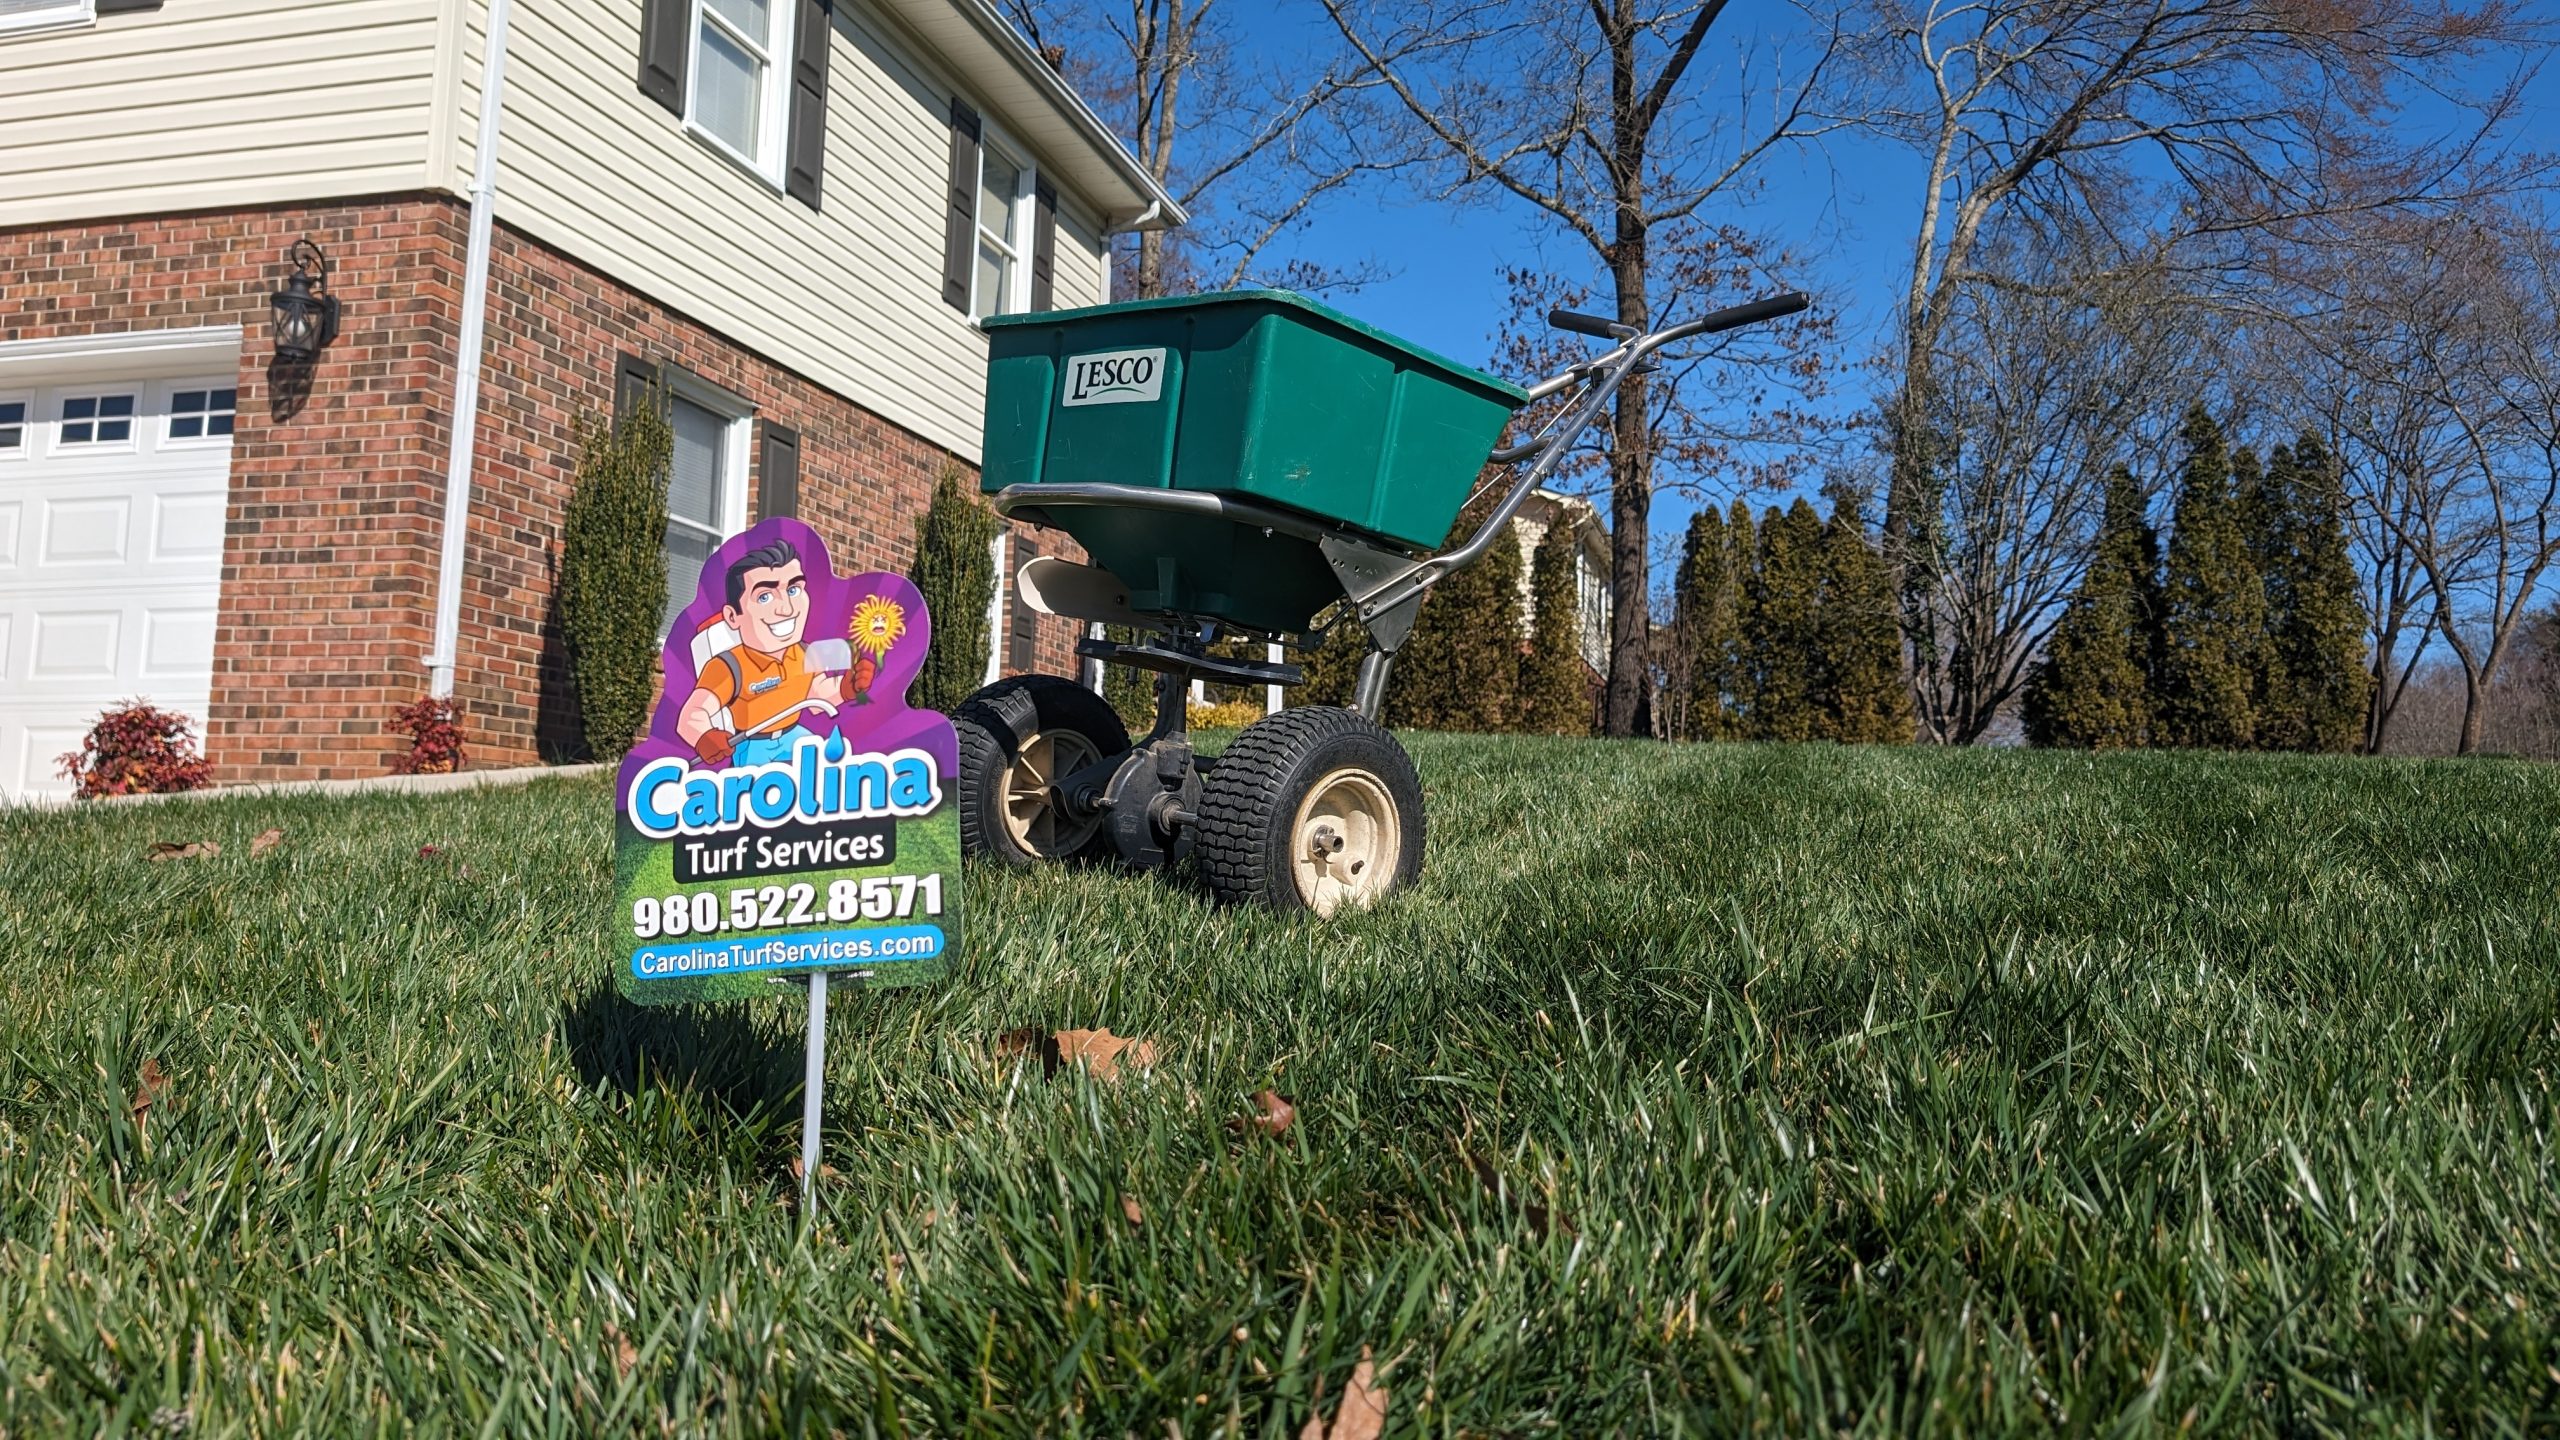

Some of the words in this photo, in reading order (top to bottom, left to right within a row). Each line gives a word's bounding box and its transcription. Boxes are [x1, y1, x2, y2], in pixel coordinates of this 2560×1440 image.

[1072, 356, 1153, 400] LESCO
[634, 725, 933, 831] Carolina
[685, 836, 750, 876] Turf
[755, 830, 885, 869] Services
[632, 873, 943, 938] 980.522.8571
[640, 934, 935, 975] CarolinaTurfServices.com
